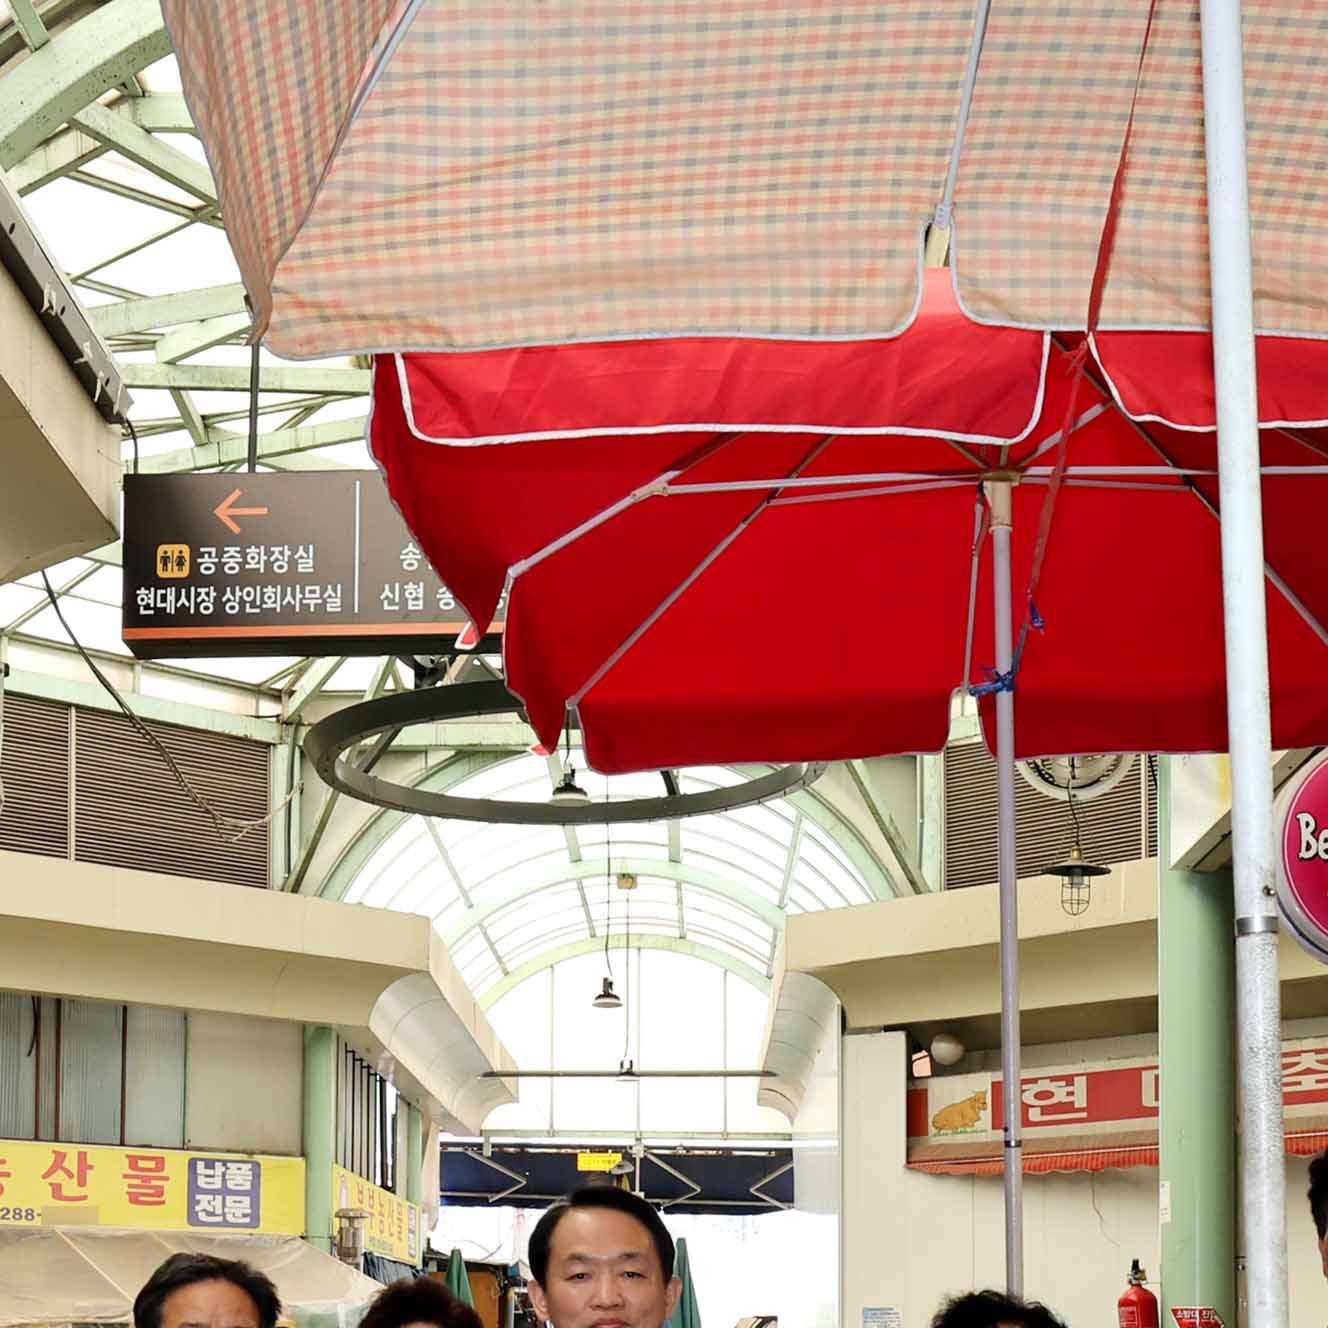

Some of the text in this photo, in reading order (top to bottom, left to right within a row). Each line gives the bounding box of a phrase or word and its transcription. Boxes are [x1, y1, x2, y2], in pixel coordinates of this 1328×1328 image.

[196, 544, 315, 575] 공중화장실
[136, 583, 342, 616] 현대시장 상인회사무실
[380, 581, 424, 611] 신협
[196, 1161, 255, 1191] 납품
[194, 1194, 252, 1225] 전문
